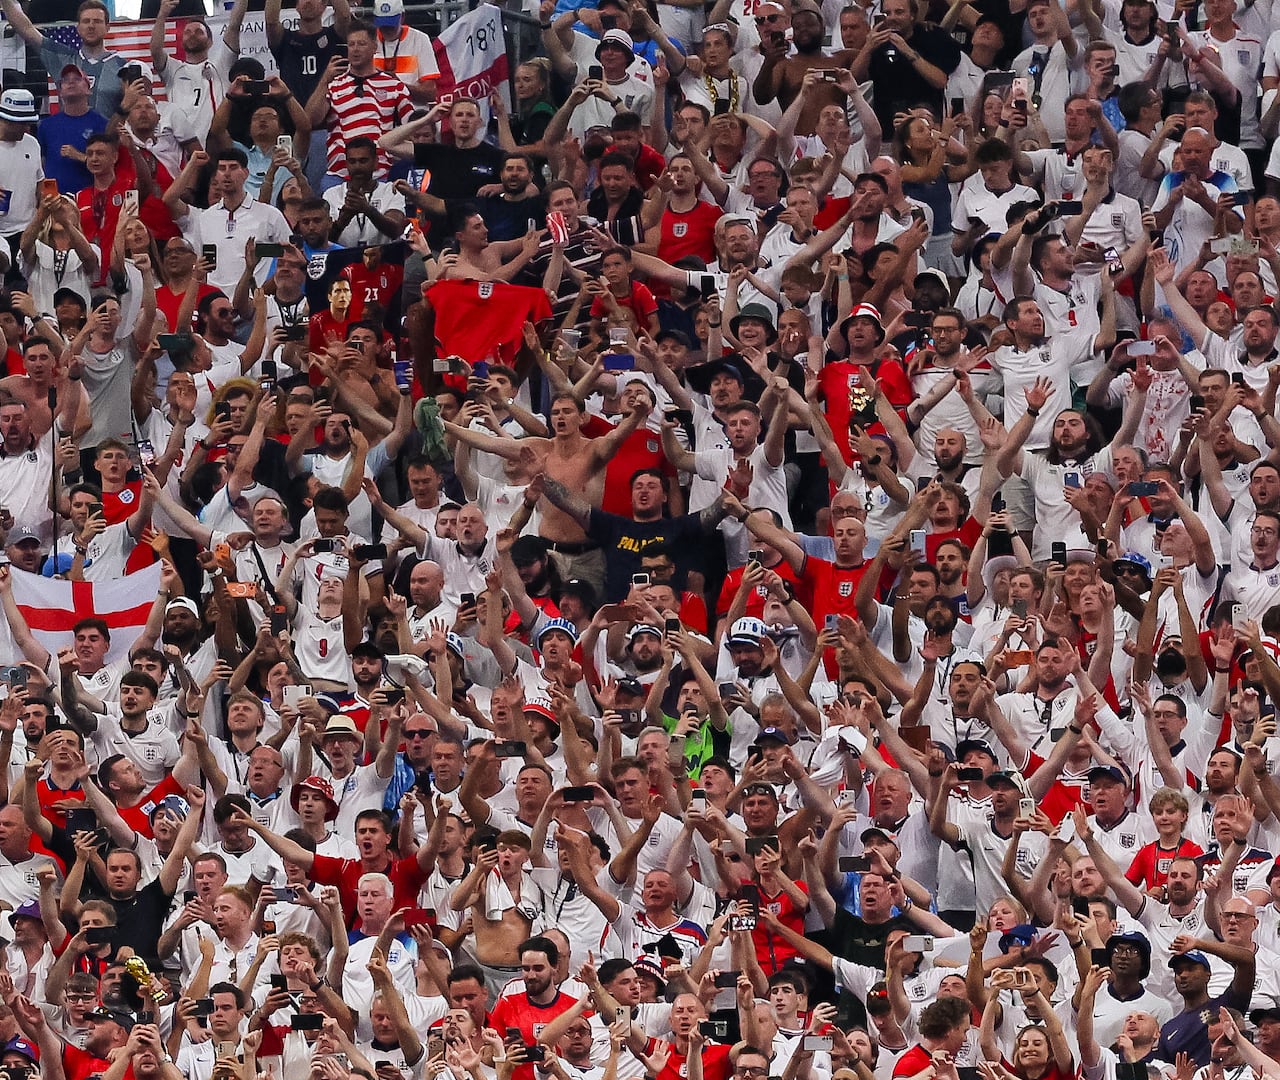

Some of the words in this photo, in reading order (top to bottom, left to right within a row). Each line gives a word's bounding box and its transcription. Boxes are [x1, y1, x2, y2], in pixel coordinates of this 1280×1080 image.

[302, 56, 317, 75] 10
[363, 287, 379, 303] 23
[319, 638, 329, 658] 9
